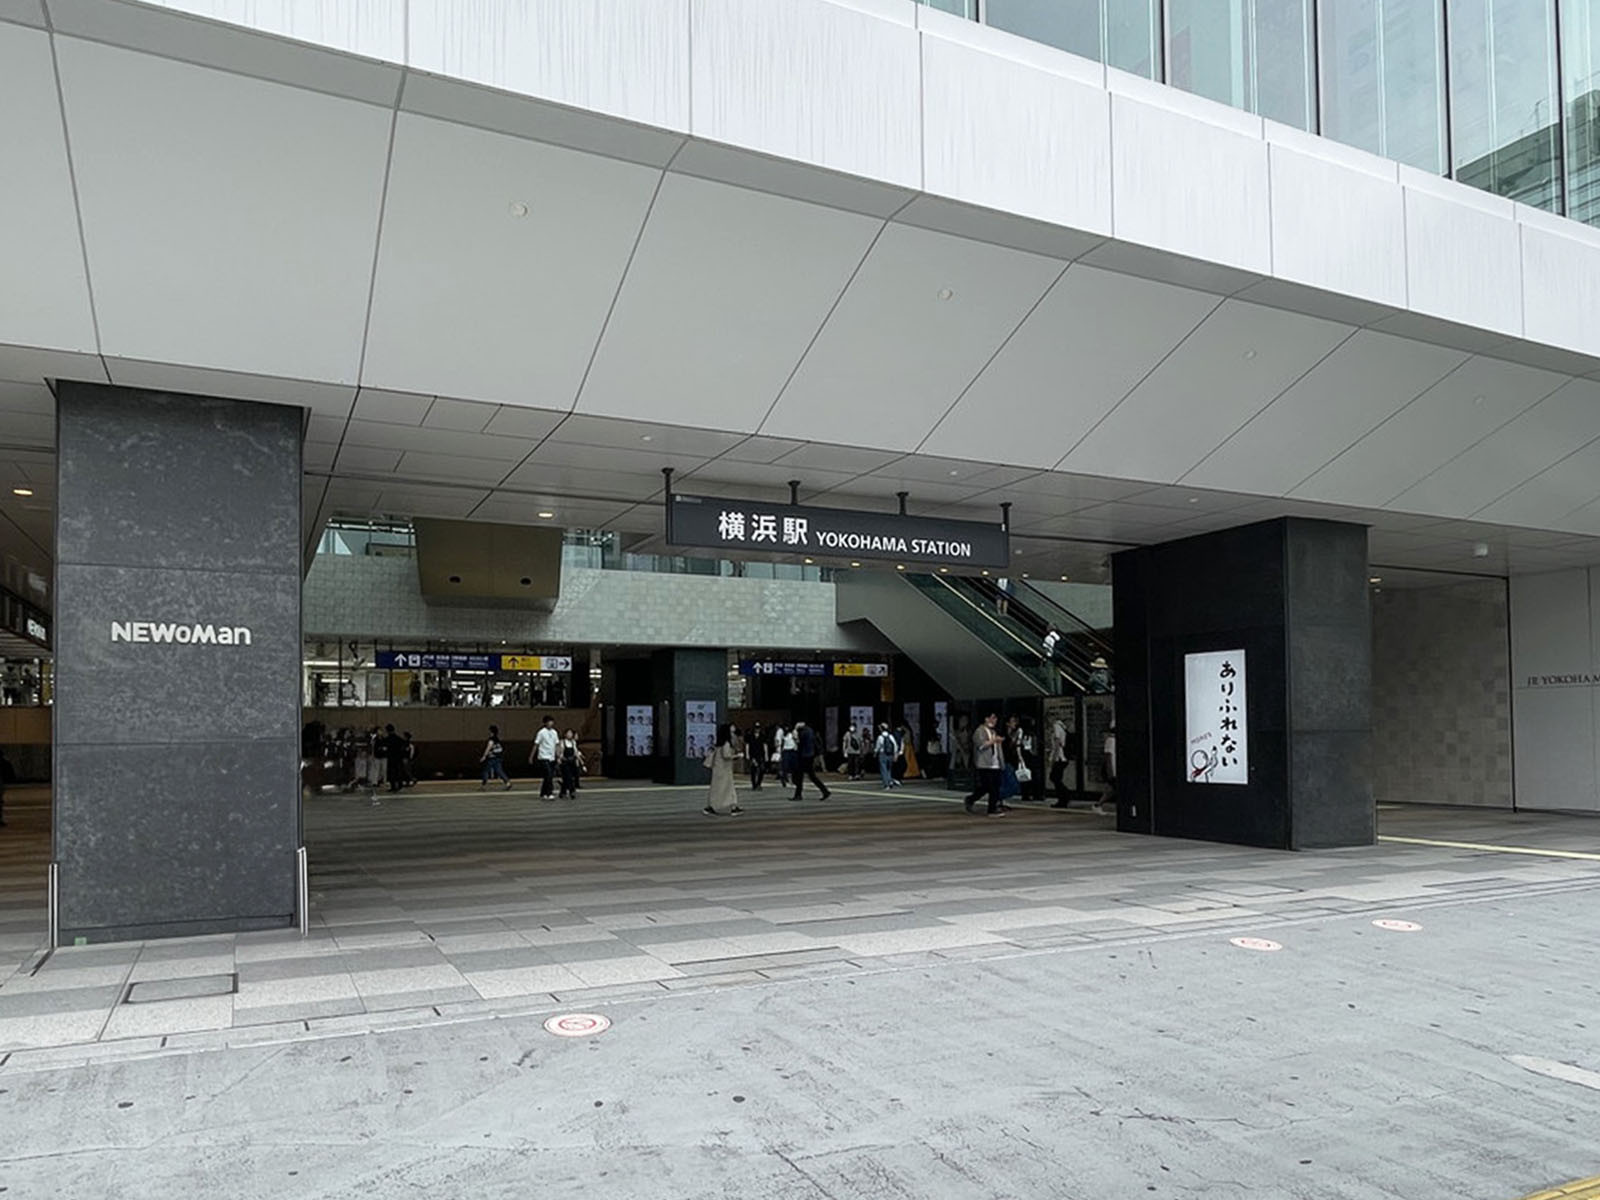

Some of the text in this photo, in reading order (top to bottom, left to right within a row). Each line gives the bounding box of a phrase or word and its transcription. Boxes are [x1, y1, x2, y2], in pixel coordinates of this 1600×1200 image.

[719, 511, 807, 544] 横浜駅
[816, 531, 971, 556] YOKOHAMA STATION
[111, 621, 251, 646] NEWoMan
[1219, 661, 1237, 767] ありふれない
